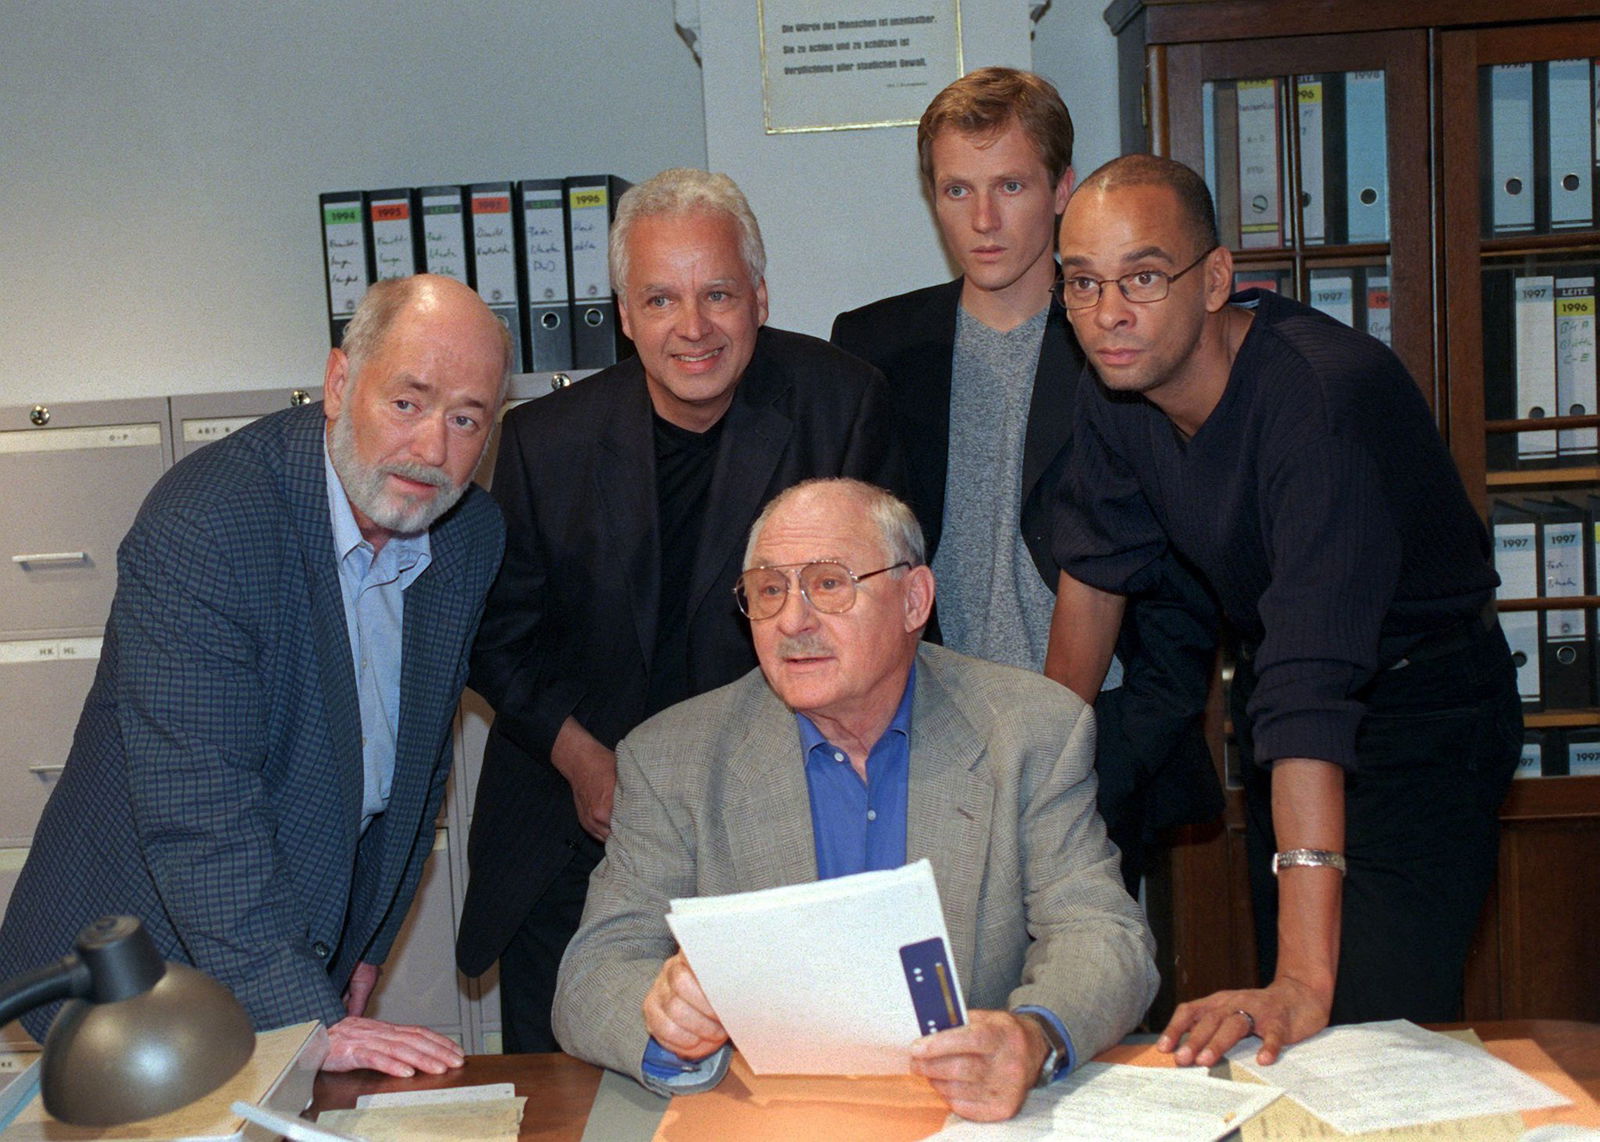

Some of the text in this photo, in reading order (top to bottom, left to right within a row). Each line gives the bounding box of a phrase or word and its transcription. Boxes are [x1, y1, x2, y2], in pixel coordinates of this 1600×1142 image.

[838, 20, 876, 29] Menschen
[576, 194, 600, 204] 1996
[332, 212, 356, 221] 1994
[378, 207, 402, 216] 1995
[1317, 292, 1343, 302] 1997
[1522, 289, 1546, 299] 1997
[1562, 303, 1588, 312] 1996
[1502, 538, 1528, 548] 1997
[1551, 534, 1576, 545] 1997
